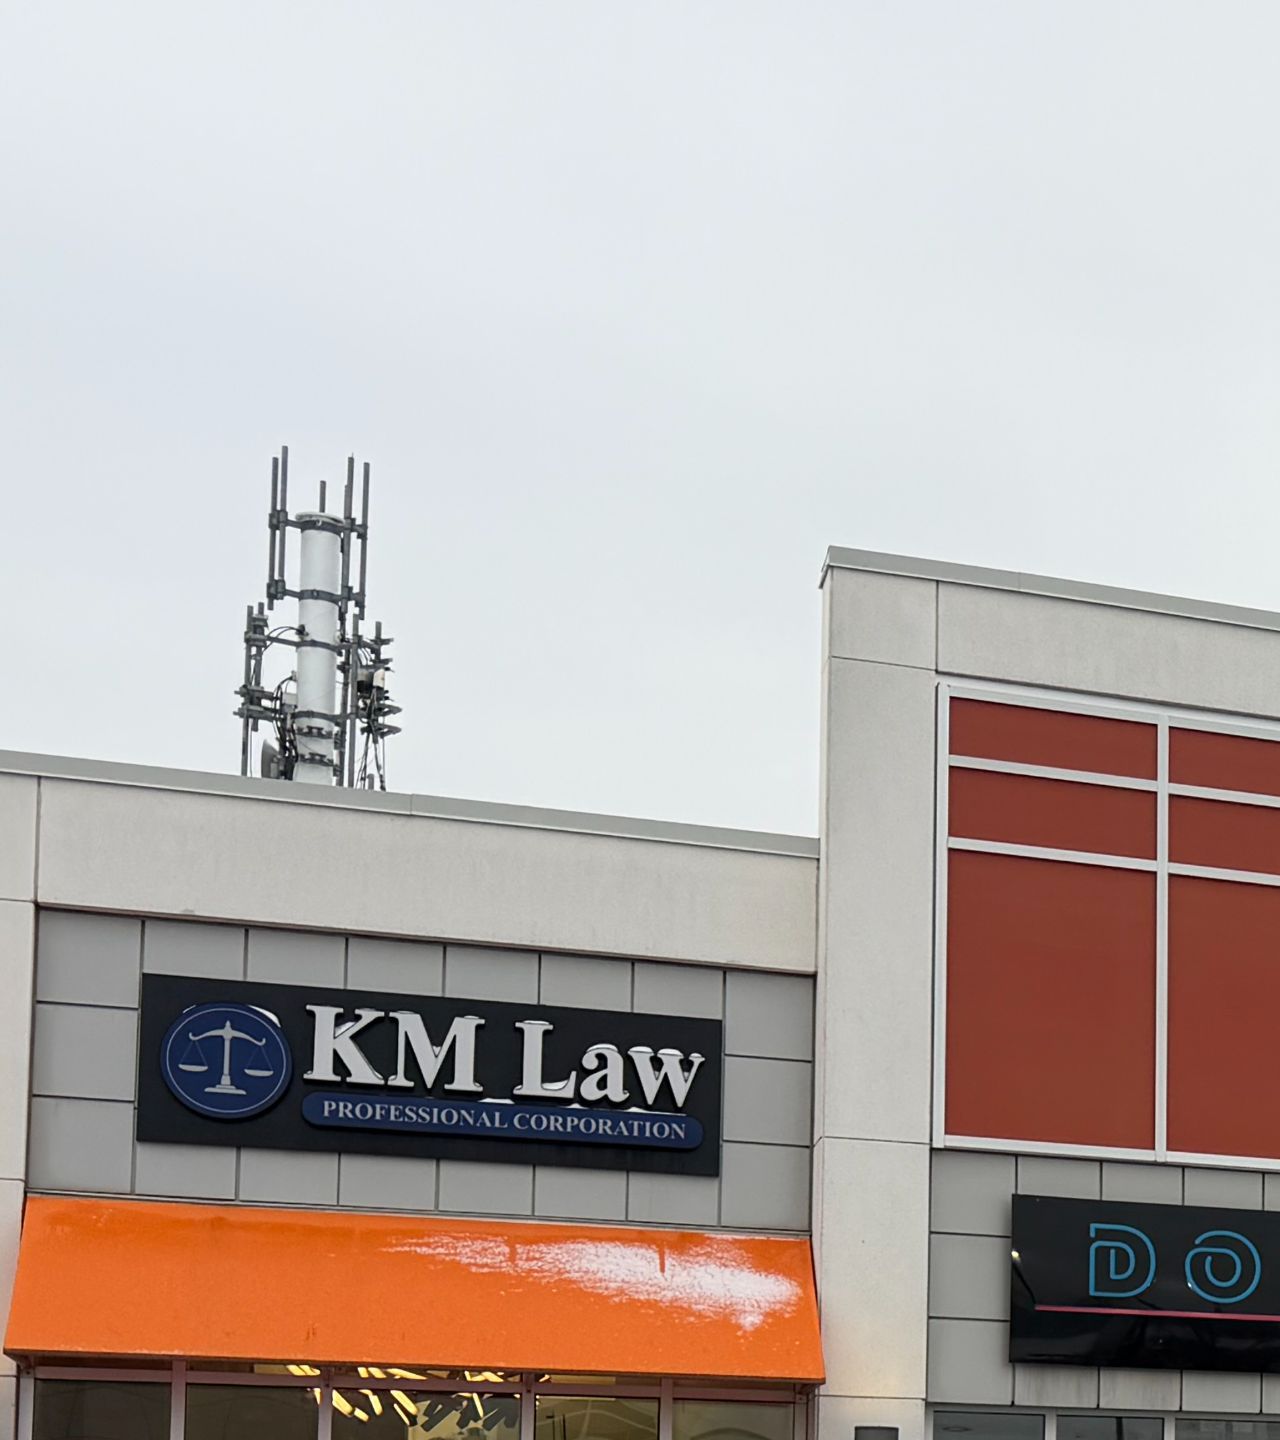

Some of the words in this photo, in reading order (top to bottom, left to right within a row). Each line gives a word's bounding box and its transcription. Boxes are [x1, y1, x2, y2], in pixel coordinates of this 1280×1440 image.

[303, 1004, 485, 1092] KM
[513, 1019, 706, 1108] Law
[323, 1100, 508, 1129] PROFESSIONAL
[514, 1113, 687, 1140] CORPORATION
